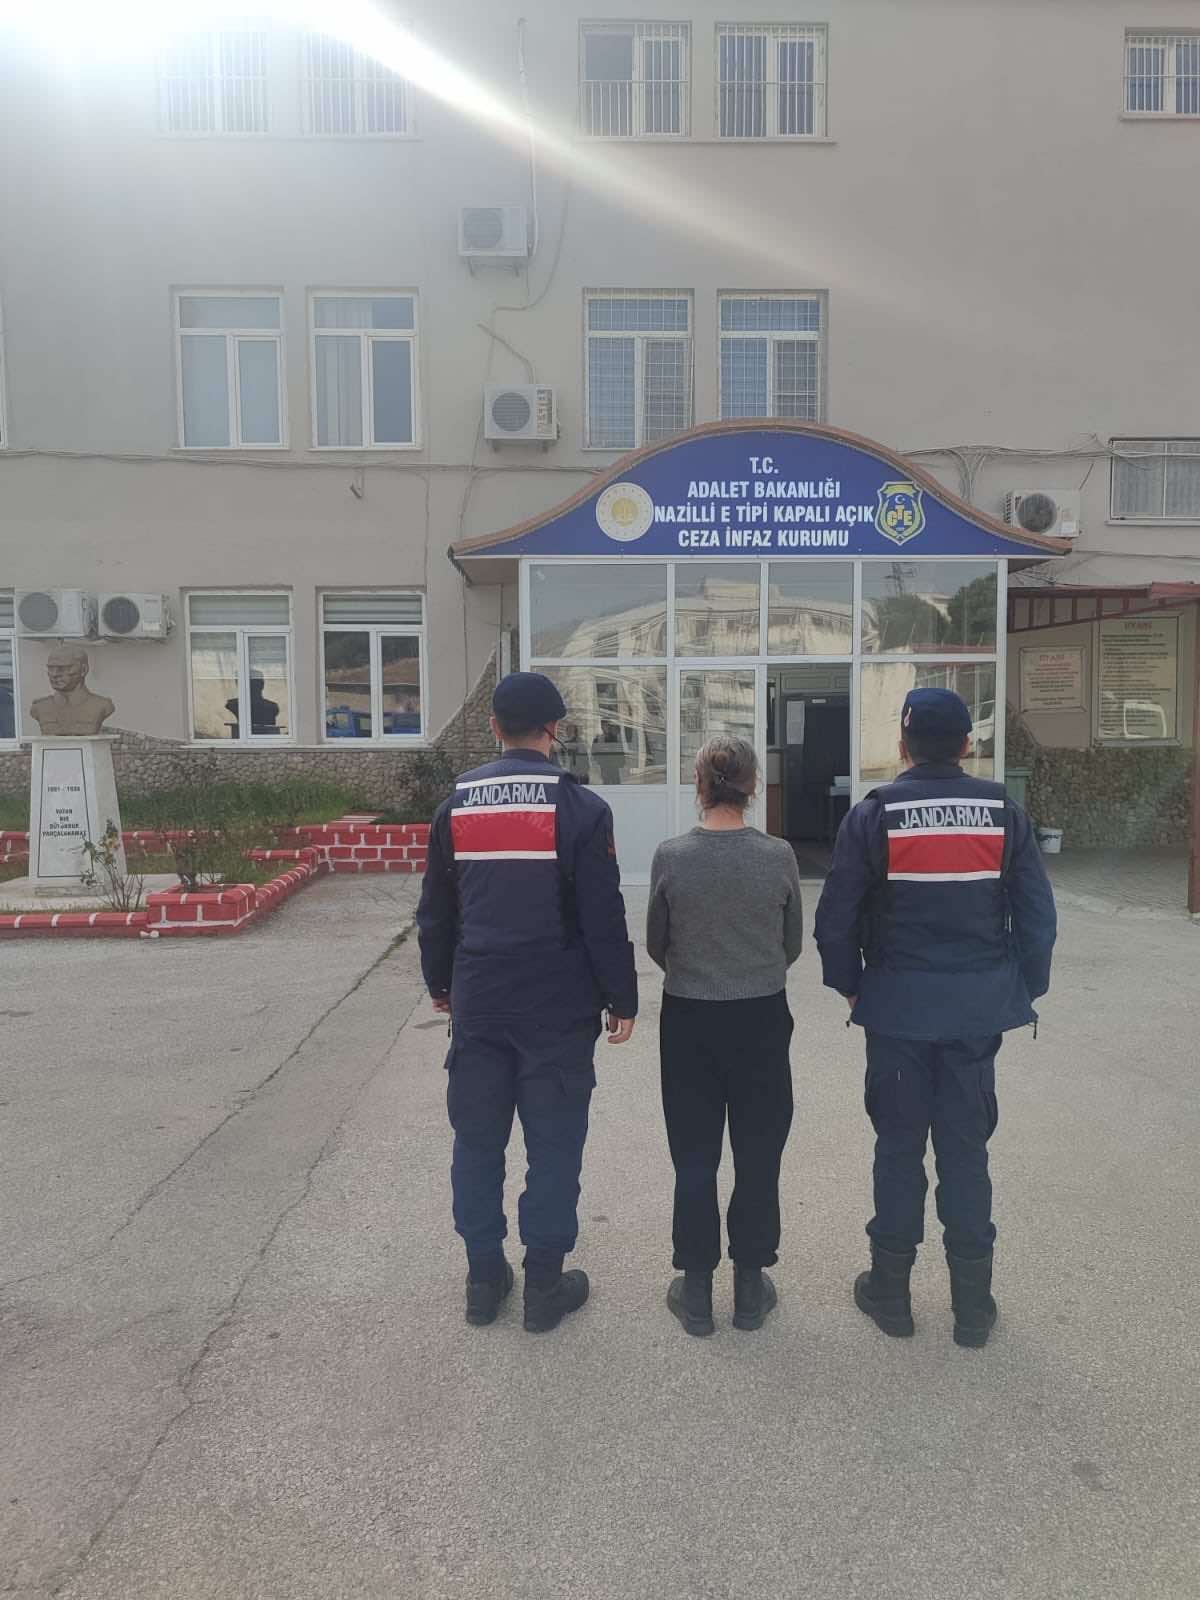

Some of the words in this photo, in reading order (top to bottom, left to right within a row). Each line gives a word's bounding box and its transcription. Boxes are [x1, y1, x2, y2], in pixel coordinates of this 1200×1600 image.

[749, 456, 779, 474] T.C.
[687, 481, 750, 498] ADALET
[754, 477, 840, 498] BAKANLIĞI
[654, 501, 716, 523] NAZİLLİ
[721, 505, 731, 523] E
[735, 501, 768, 523] TİPİ
[773, 505, 830, 523] KAPALI
[835, 505, 875, 527] AÇIK
[678, 529, 720, 547] CEZA
[725, 525, 772, 547] İNFAZ
[777, 529, 849, 547] KURUMU
[463, 783, 547, 807] JANDARMA
[900, 806, 994, 829] JANDARMA
